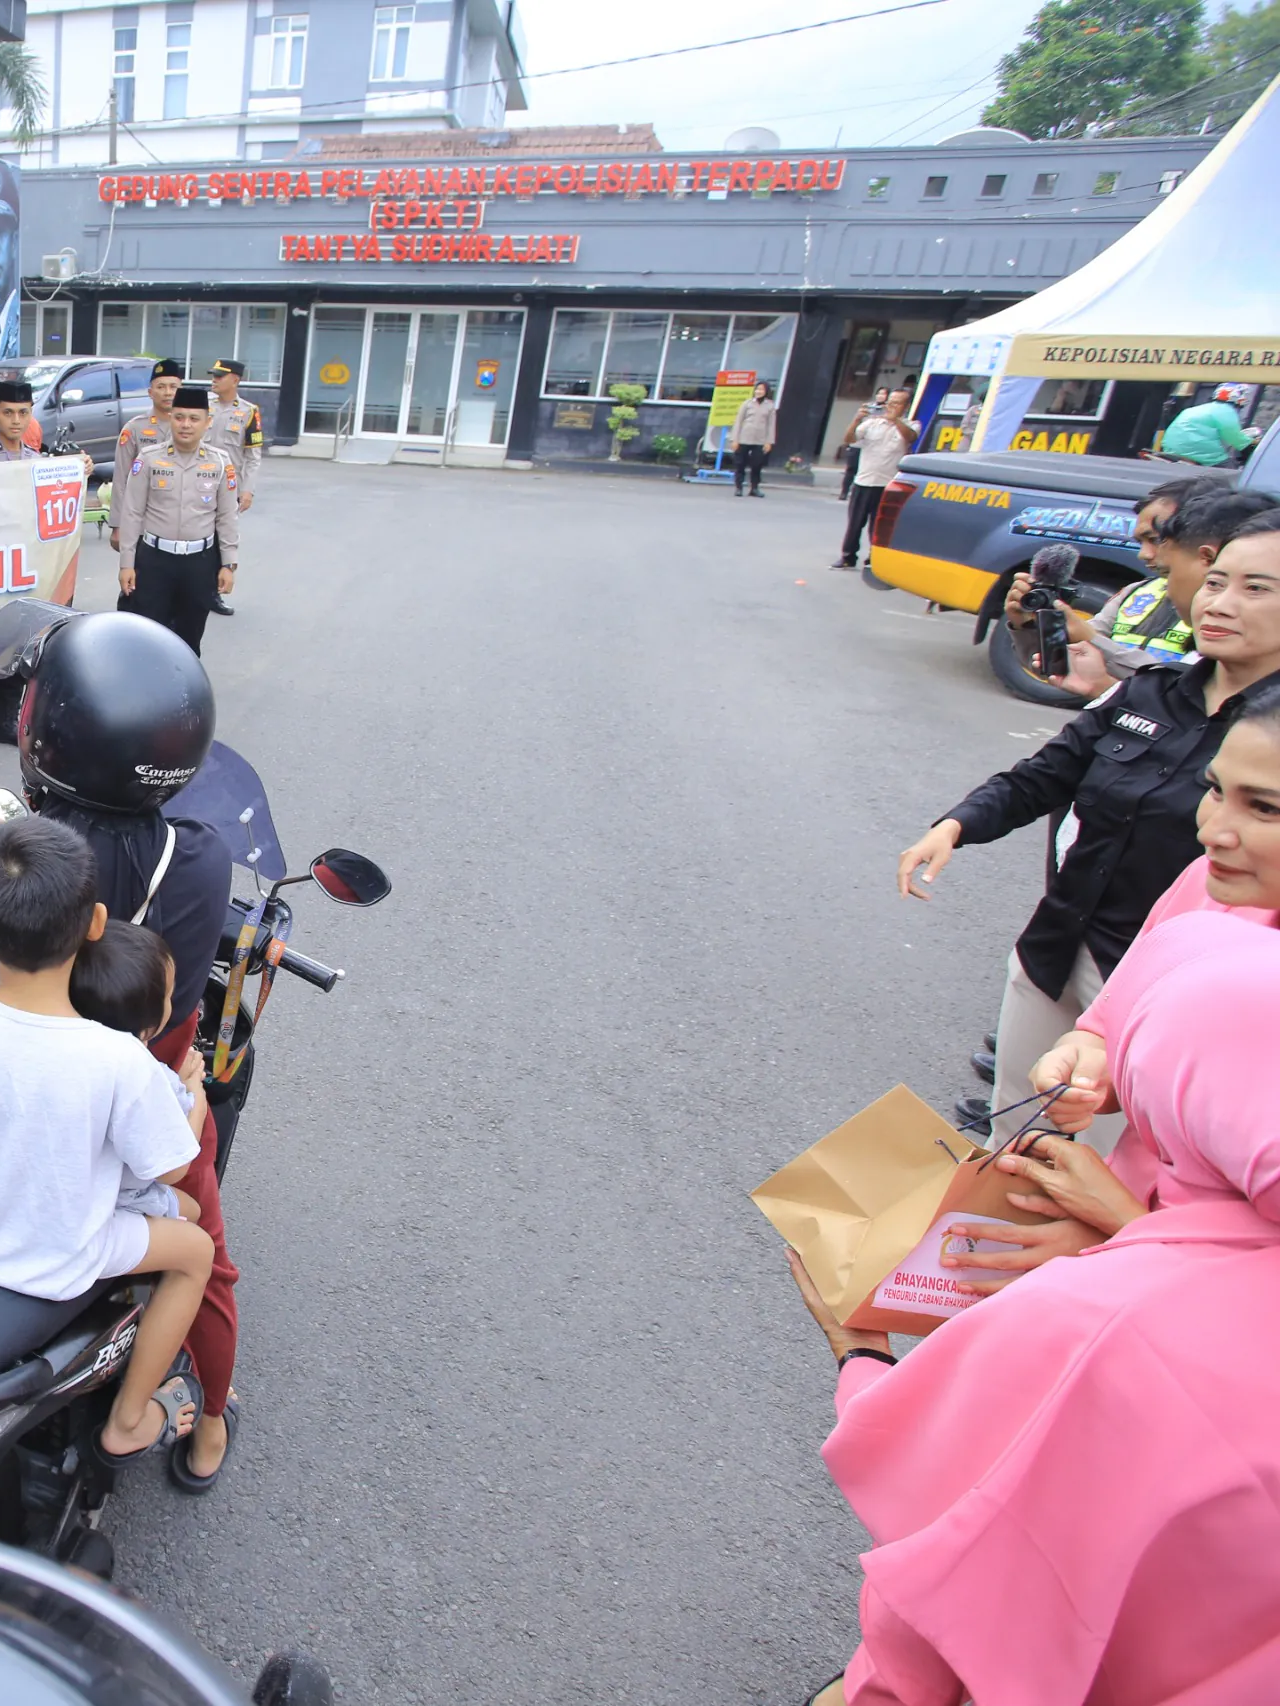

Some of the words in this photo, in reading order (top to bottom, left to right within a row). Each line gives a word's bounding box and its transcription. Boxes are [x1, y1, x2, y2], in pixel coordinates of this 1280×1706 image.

[99, 174, 199, 203] GEDUNG
[207, 171, 312, 200] SENTRA
[320, 166, 486, 199] PELAYANAN
[493, 162, 680, 195] KEPOLISIAN
[689, 159, 847, 191] TERPADU
[282, 234, 382, 262] TANTYA
[391, 234, 580, 263] SUDHIRAJATI
[1043, 346, 1166, 365] KEPOLISIAN
[1167, 349, 1253, 366] NEGARA
[152, 469, 174, 477] BAGUS
[922, 481, 1011, 509] PAMAPTA
[43, 496, 77, 526] 110
[1116, 713, 1158, 736] ANITA
[883, 1288, 918, 1302] PENGURUS
[918, 1293, 943, 1306] CABANG
